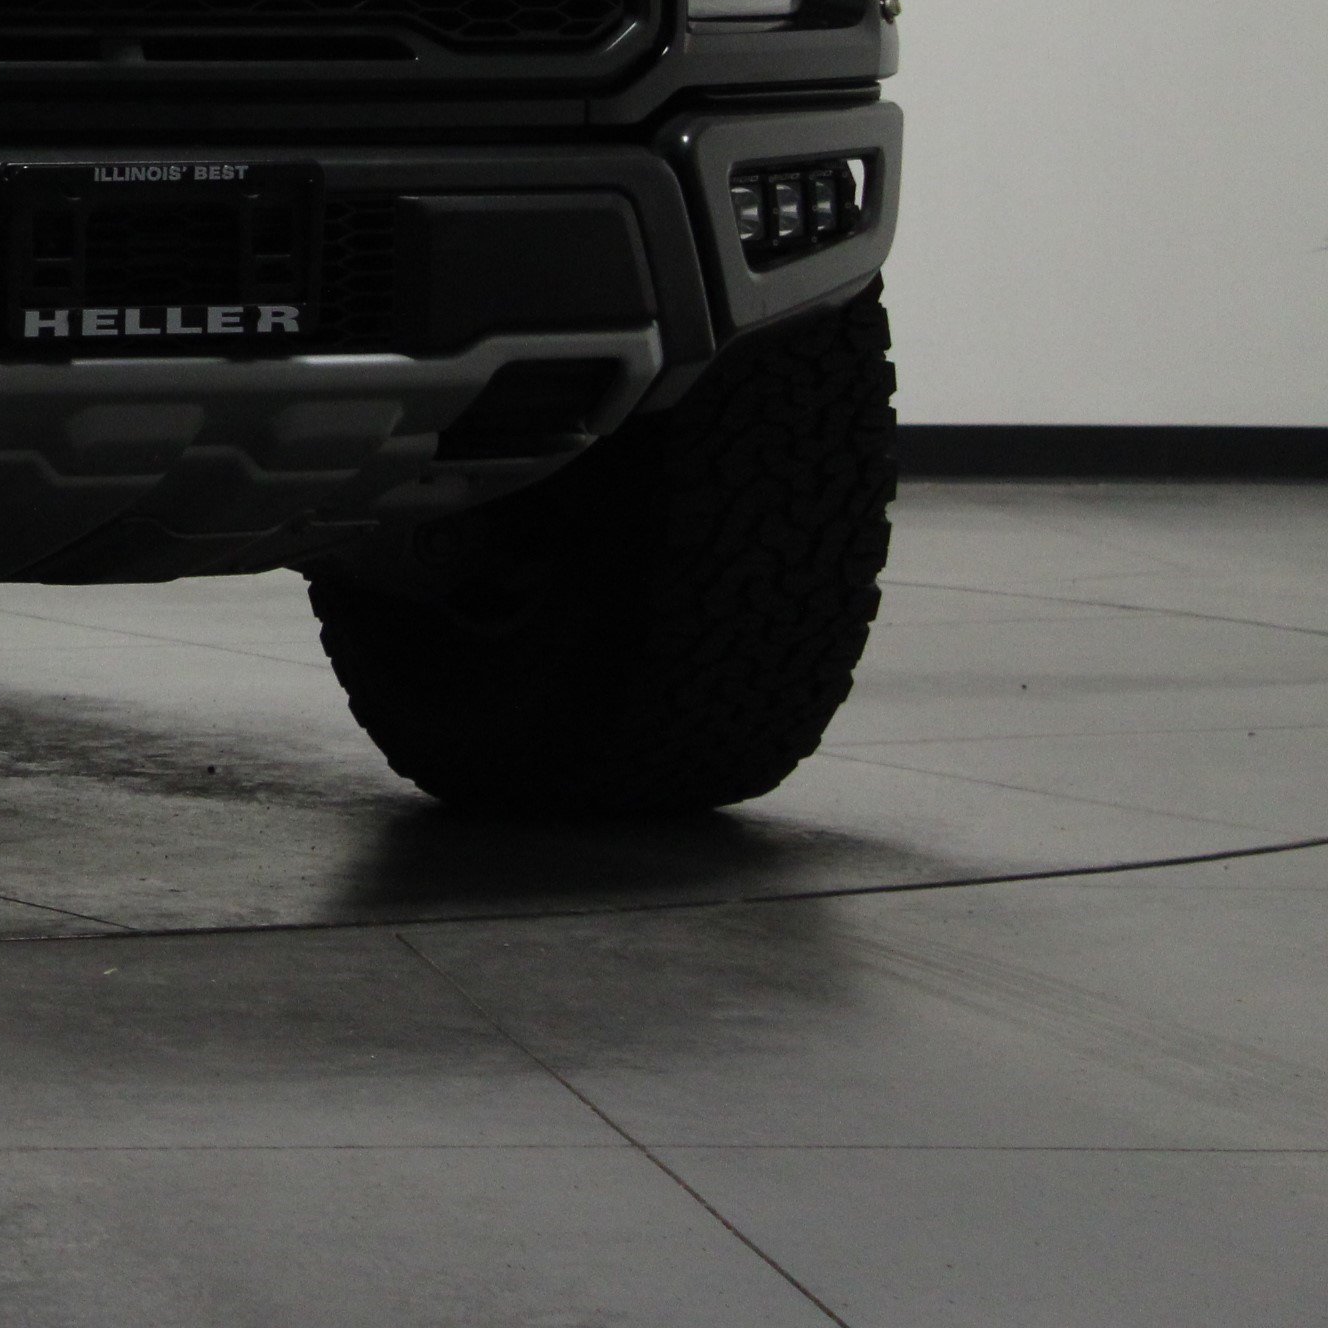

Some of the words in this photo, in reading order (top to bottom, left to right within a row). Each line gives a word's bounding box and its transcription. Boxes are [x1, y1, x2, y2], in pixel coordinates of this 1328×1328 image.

[94, 166, 188, 182] ILLINOIS'
[193, 165, 249, 181] BEST
[24, 305, 300, 337] HELLER
